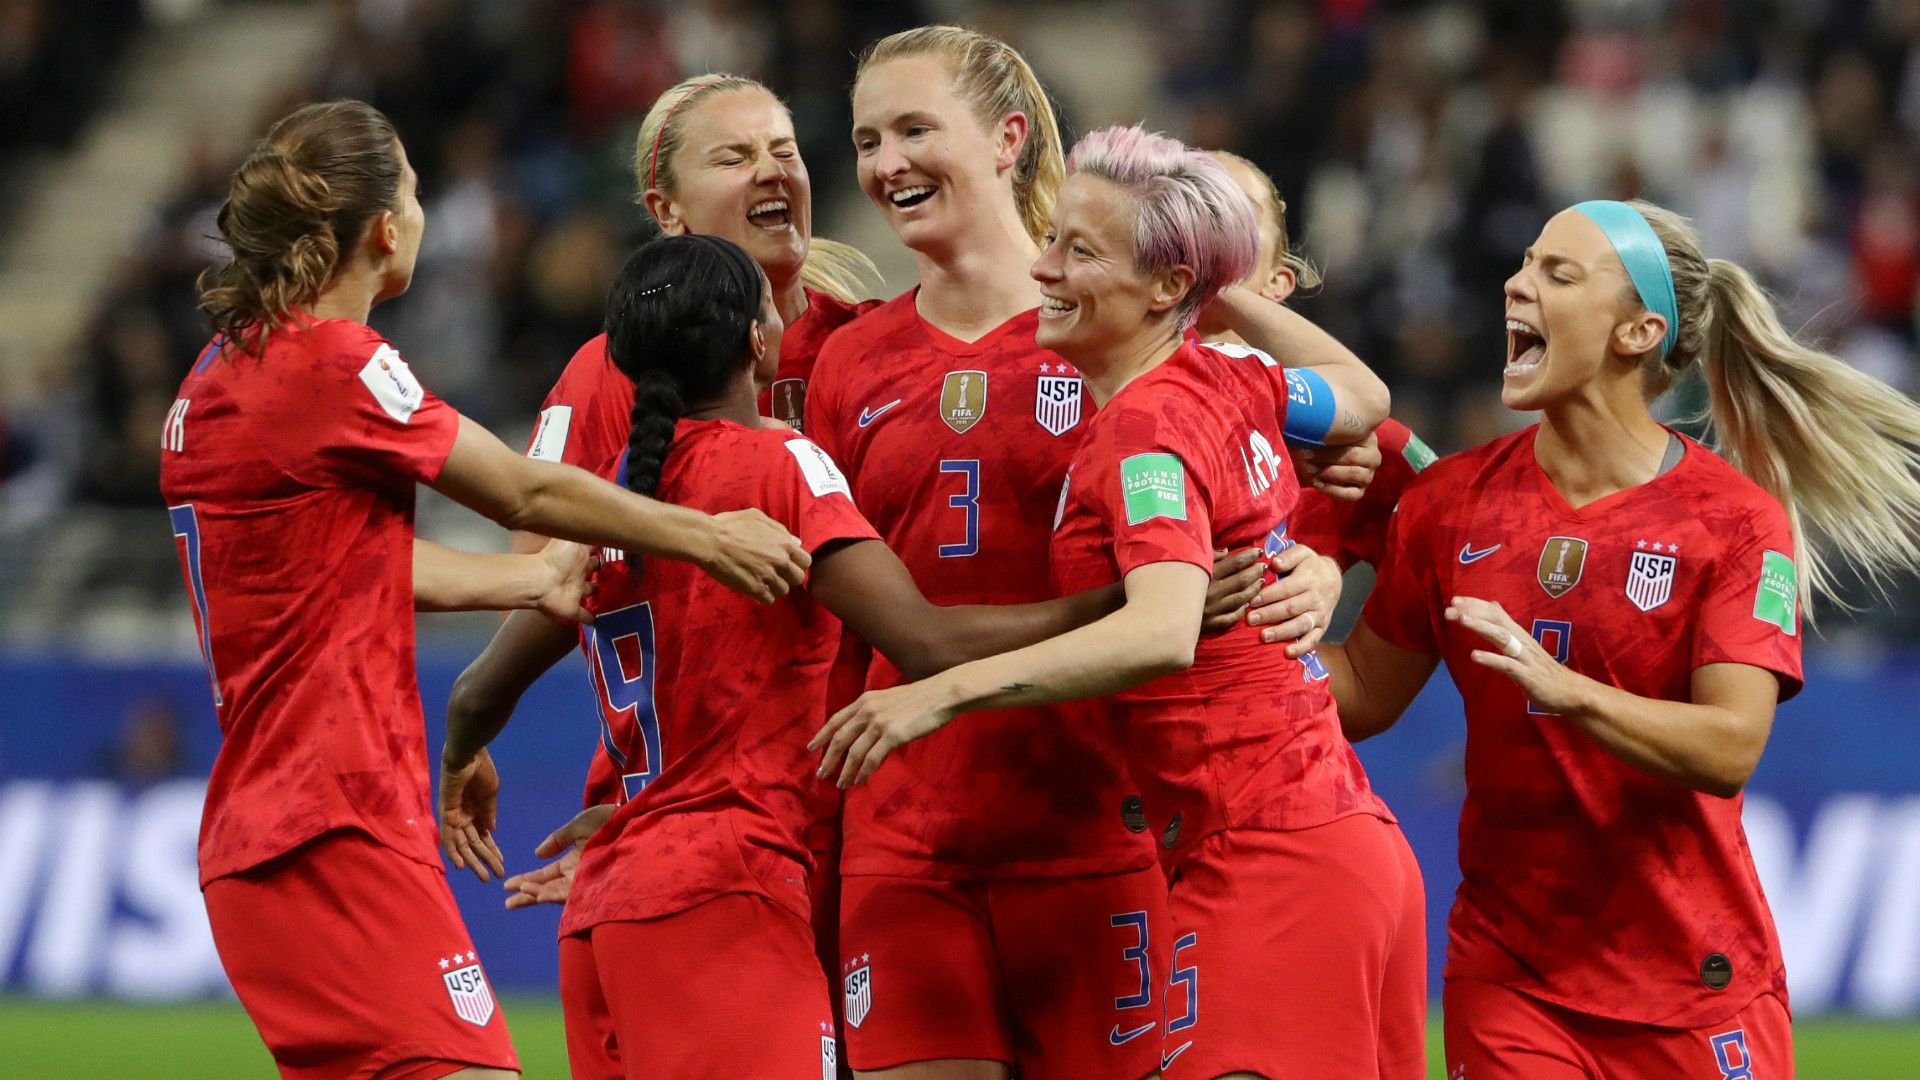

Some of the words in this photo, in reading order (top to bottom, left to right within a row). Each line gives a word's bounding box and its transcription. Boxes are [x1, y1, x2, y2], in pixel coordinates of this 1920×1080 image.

[1041, 380, 1079, 402] USA
[951, 408, 972, 418] FIFA
[1127, 470, 1178, 483] LIVING
[1128, 477, 1178, 490] FOOTBALL
[1157, 490, 1179, 502] FIFA
[939, 459, 980, 558] 3
[1548, 572, 1568, 582] FIFA
[1634, 556, 1672, 579] USA
[1111, 910, 1150, 1009] 3
[448, 968, 482, 993] USA
[846, 970, 867, 995] USA
